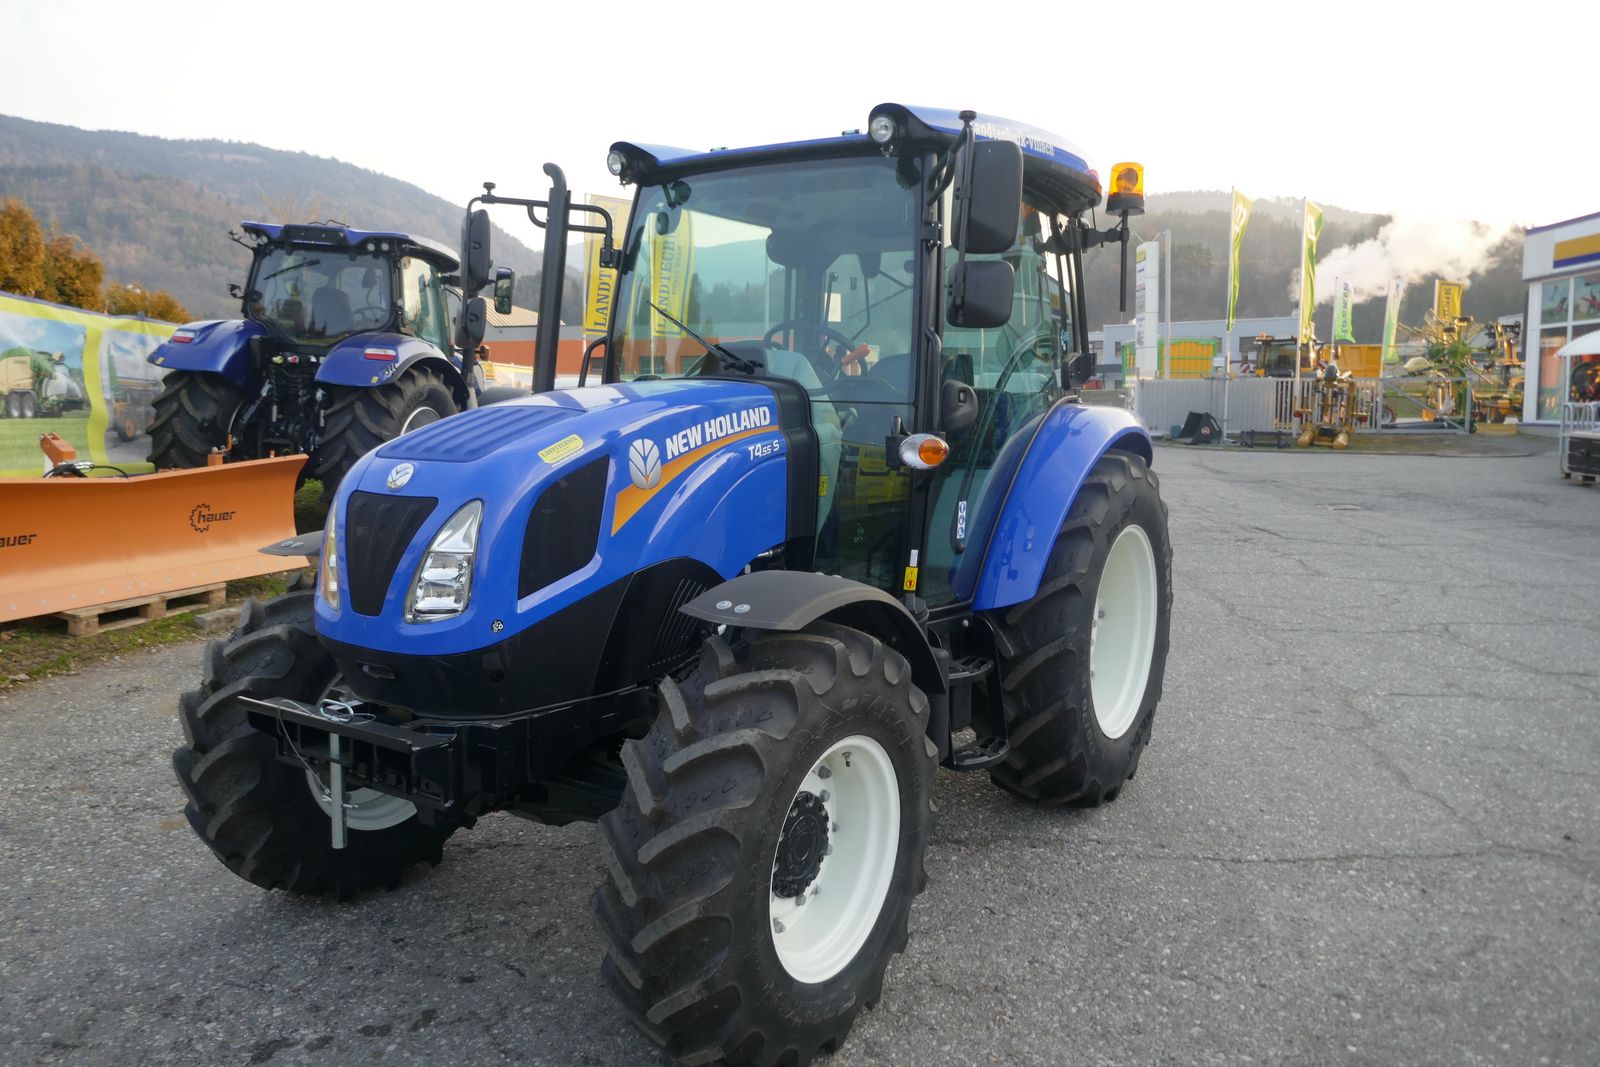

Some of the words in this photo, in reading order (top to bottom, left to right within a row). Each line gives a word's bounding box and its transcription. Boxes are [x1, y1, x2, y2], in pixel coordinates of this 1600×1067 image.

[665, 423, 702, 460] NEW
[704, 406, 771, 442] HOLLAND
[197, 510, 237, 524] hauer
